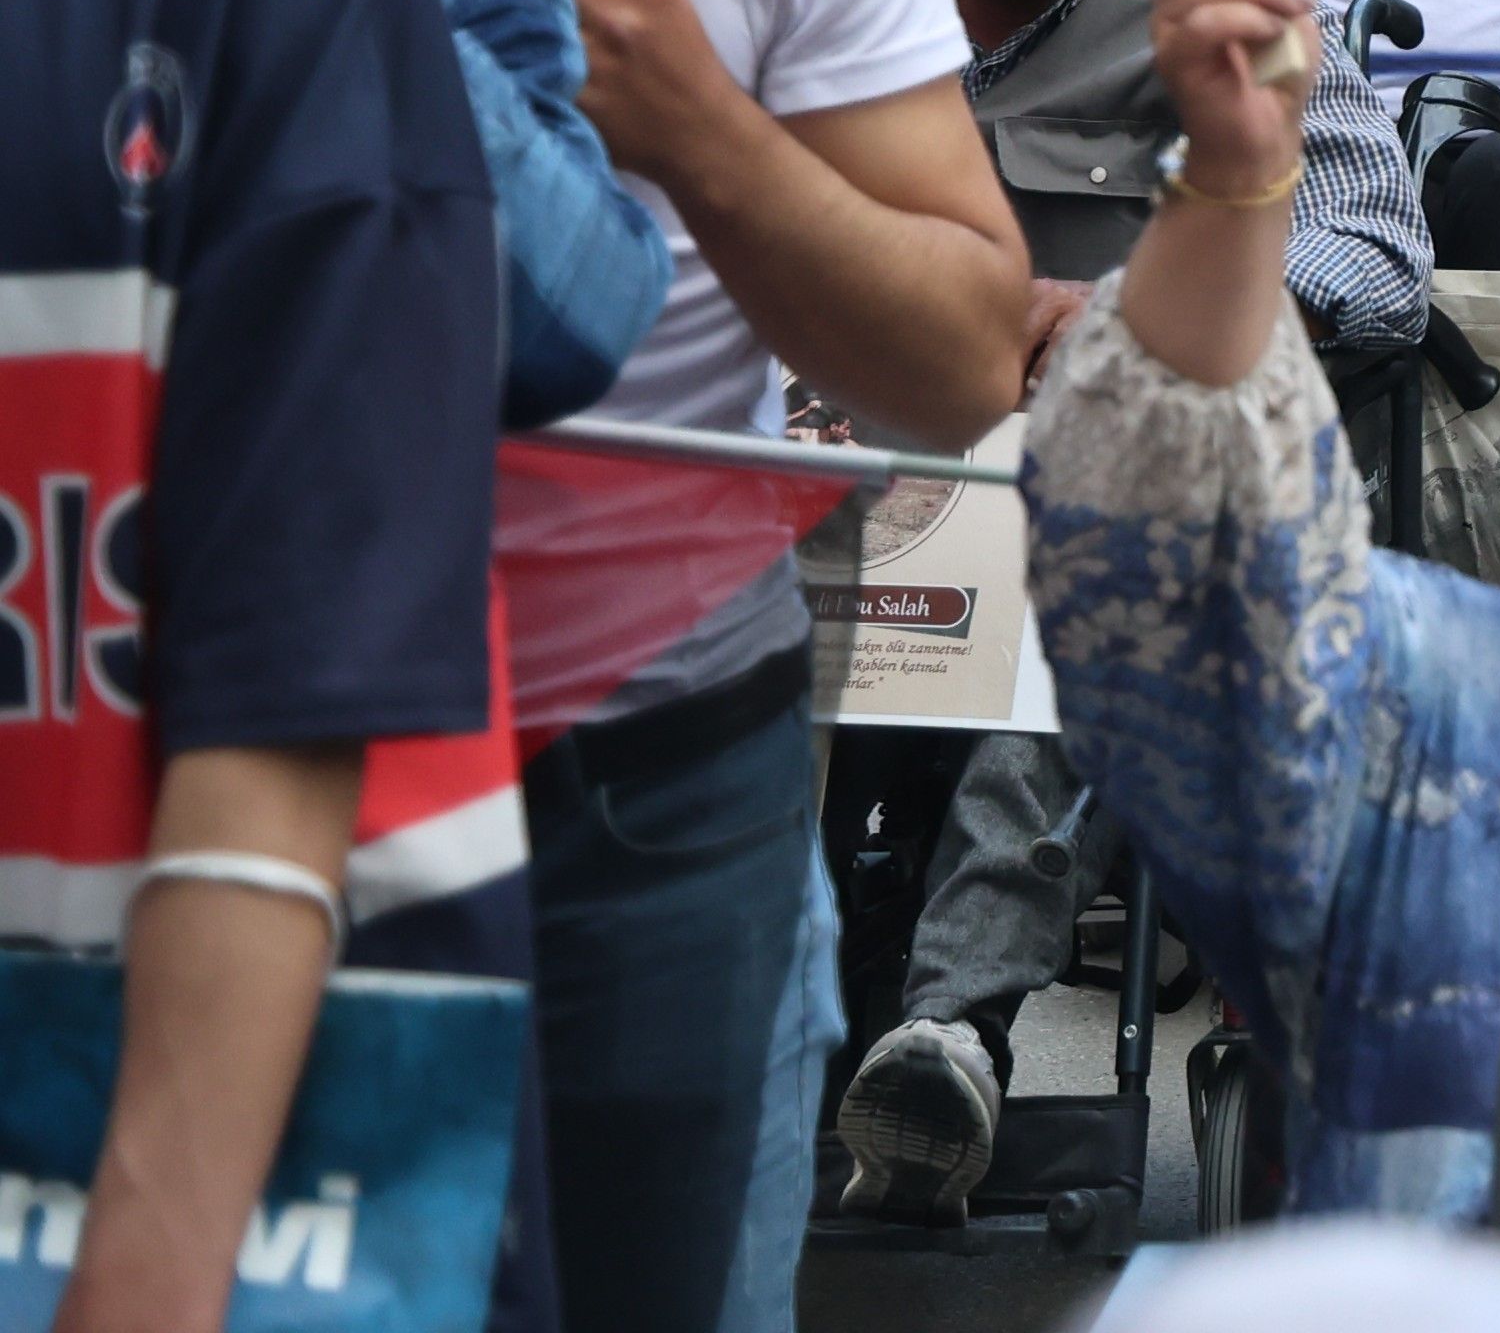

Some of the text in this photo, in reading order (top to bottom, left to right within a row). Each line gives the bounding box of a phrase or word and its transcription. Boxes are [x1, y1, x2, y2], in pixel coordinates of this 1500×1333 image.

[877, 592, 930, 618] Salah
[885, 639, 905, 653] ölü
[908, 641, 974, 656] zannetme!
[853, 659, 898, 673] Rableri
[900, 660, 948, 675] katında
